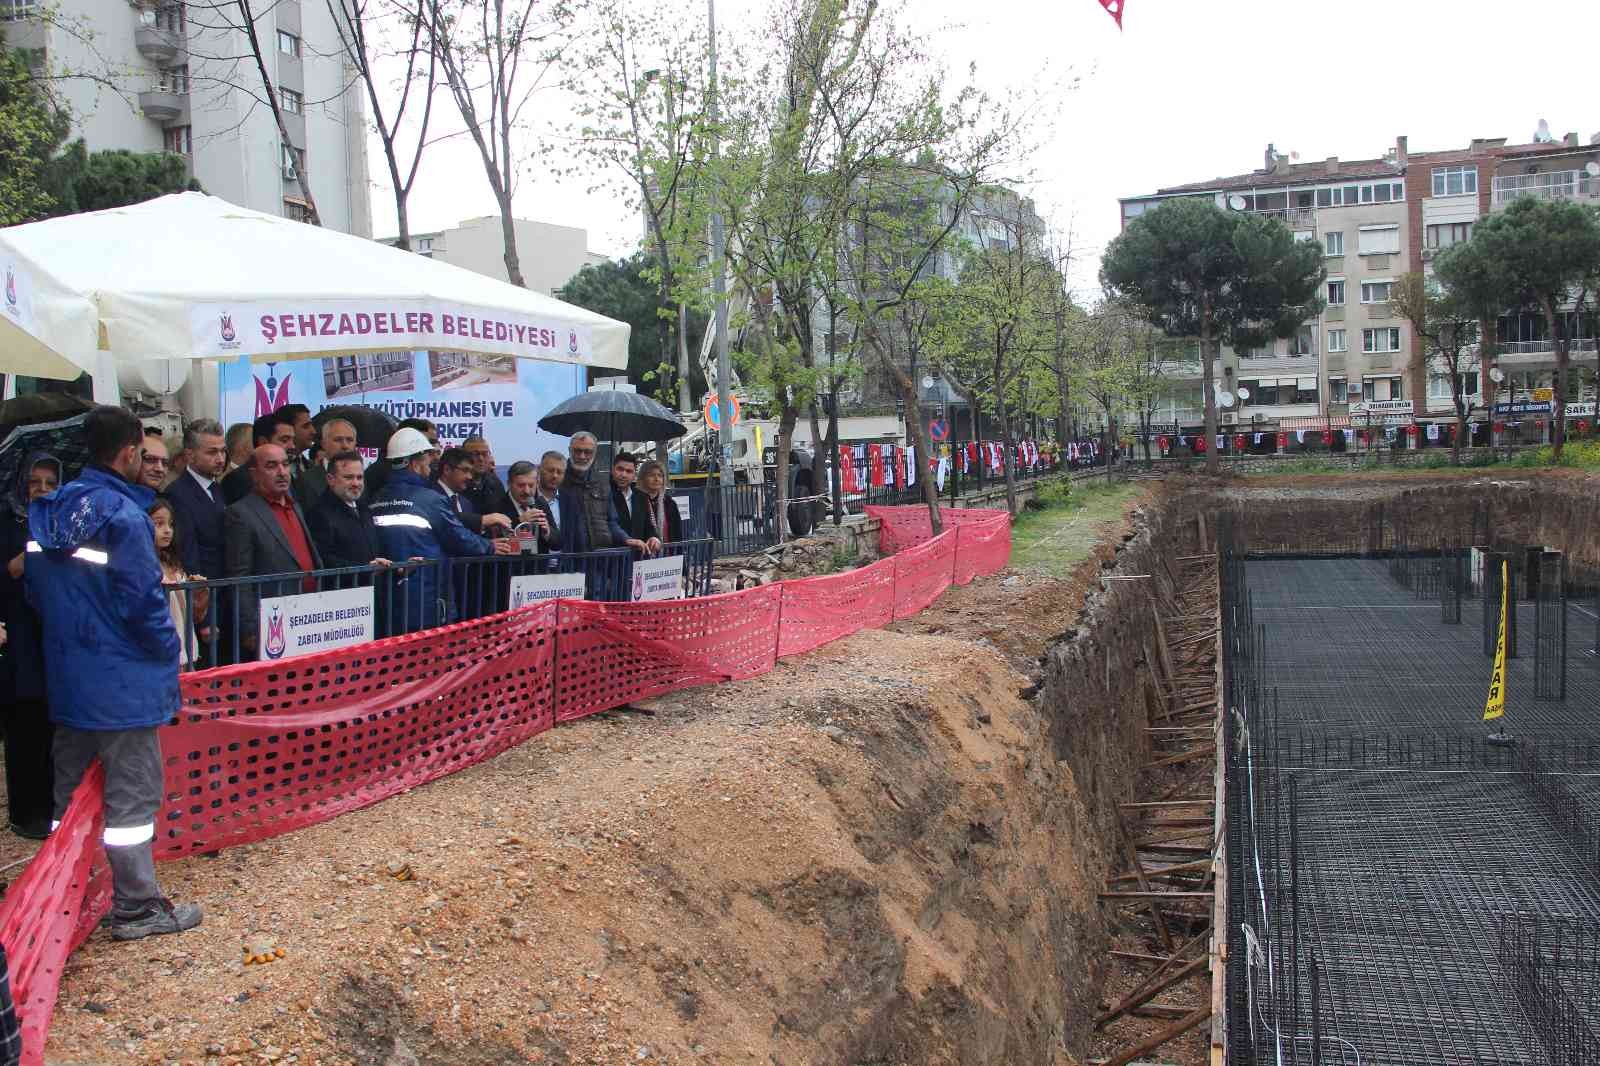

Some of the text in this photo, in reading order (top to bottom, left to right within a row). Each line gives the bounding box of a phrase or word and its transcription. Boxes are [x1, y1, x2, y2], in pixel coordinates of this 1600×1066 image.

[260, 312, 434, 344] ŞEHZADELER
[490, 400, 513, 417] VE
[289, 610, 334, 630] ŞEHZADELER
[297, 623, 365, 646] ZABITA MÜDÜRLÜĞÜ
